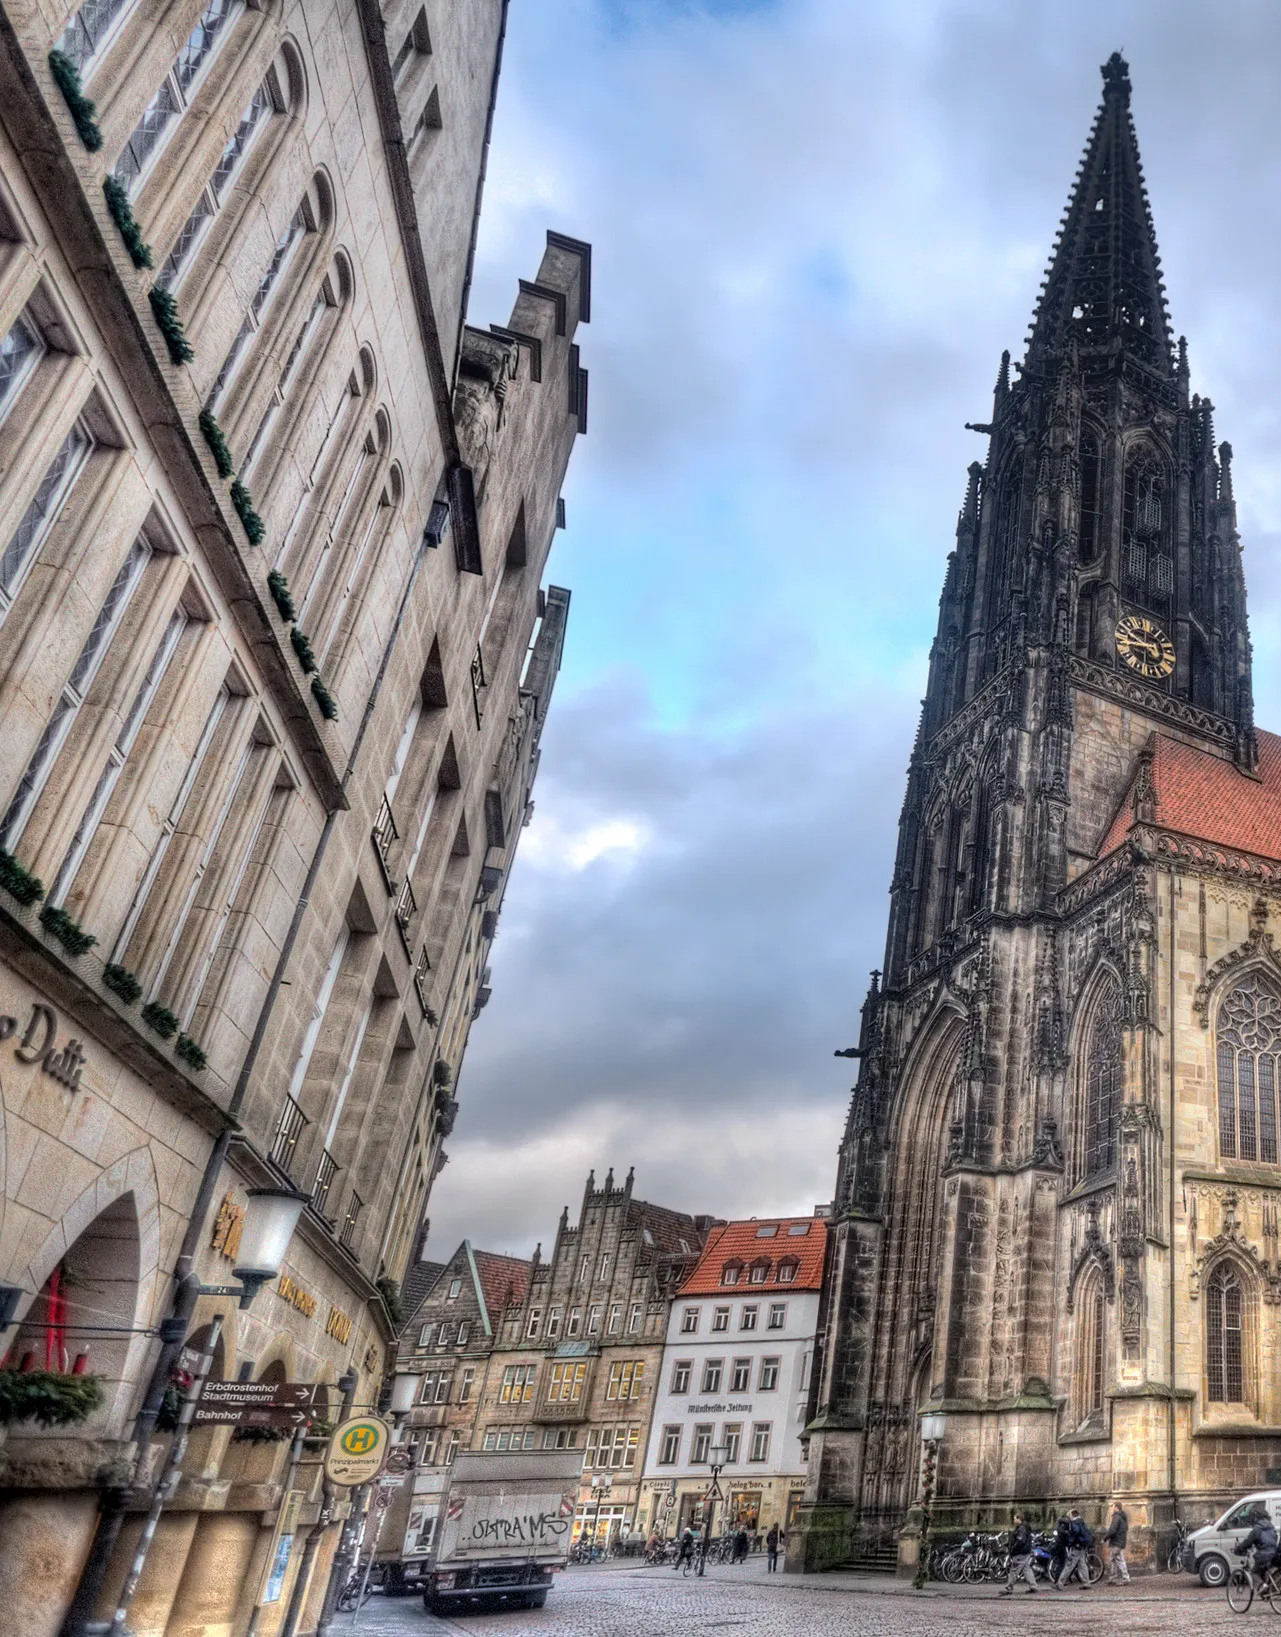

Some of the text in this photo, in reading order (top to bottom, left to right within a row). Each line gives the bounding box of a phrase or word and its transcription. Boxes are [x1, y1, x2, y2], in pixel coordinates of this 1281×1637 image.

[14, 1003, 87, 1096] Dutti
[217, 1286, 227, 1294] 24
[205, 1382, 279, 1393] Erbdrostenhof
[202, 1391, 274, 1401] Stadtmuseum
[688, 1403, 753, 1414] Münstersche Zeitung
[195, 1410, 243, 1420] Bahnhof
[349, 1431, 371, 1449] H
[330, 1458, 380, 1466] Prinzipalmarkt
